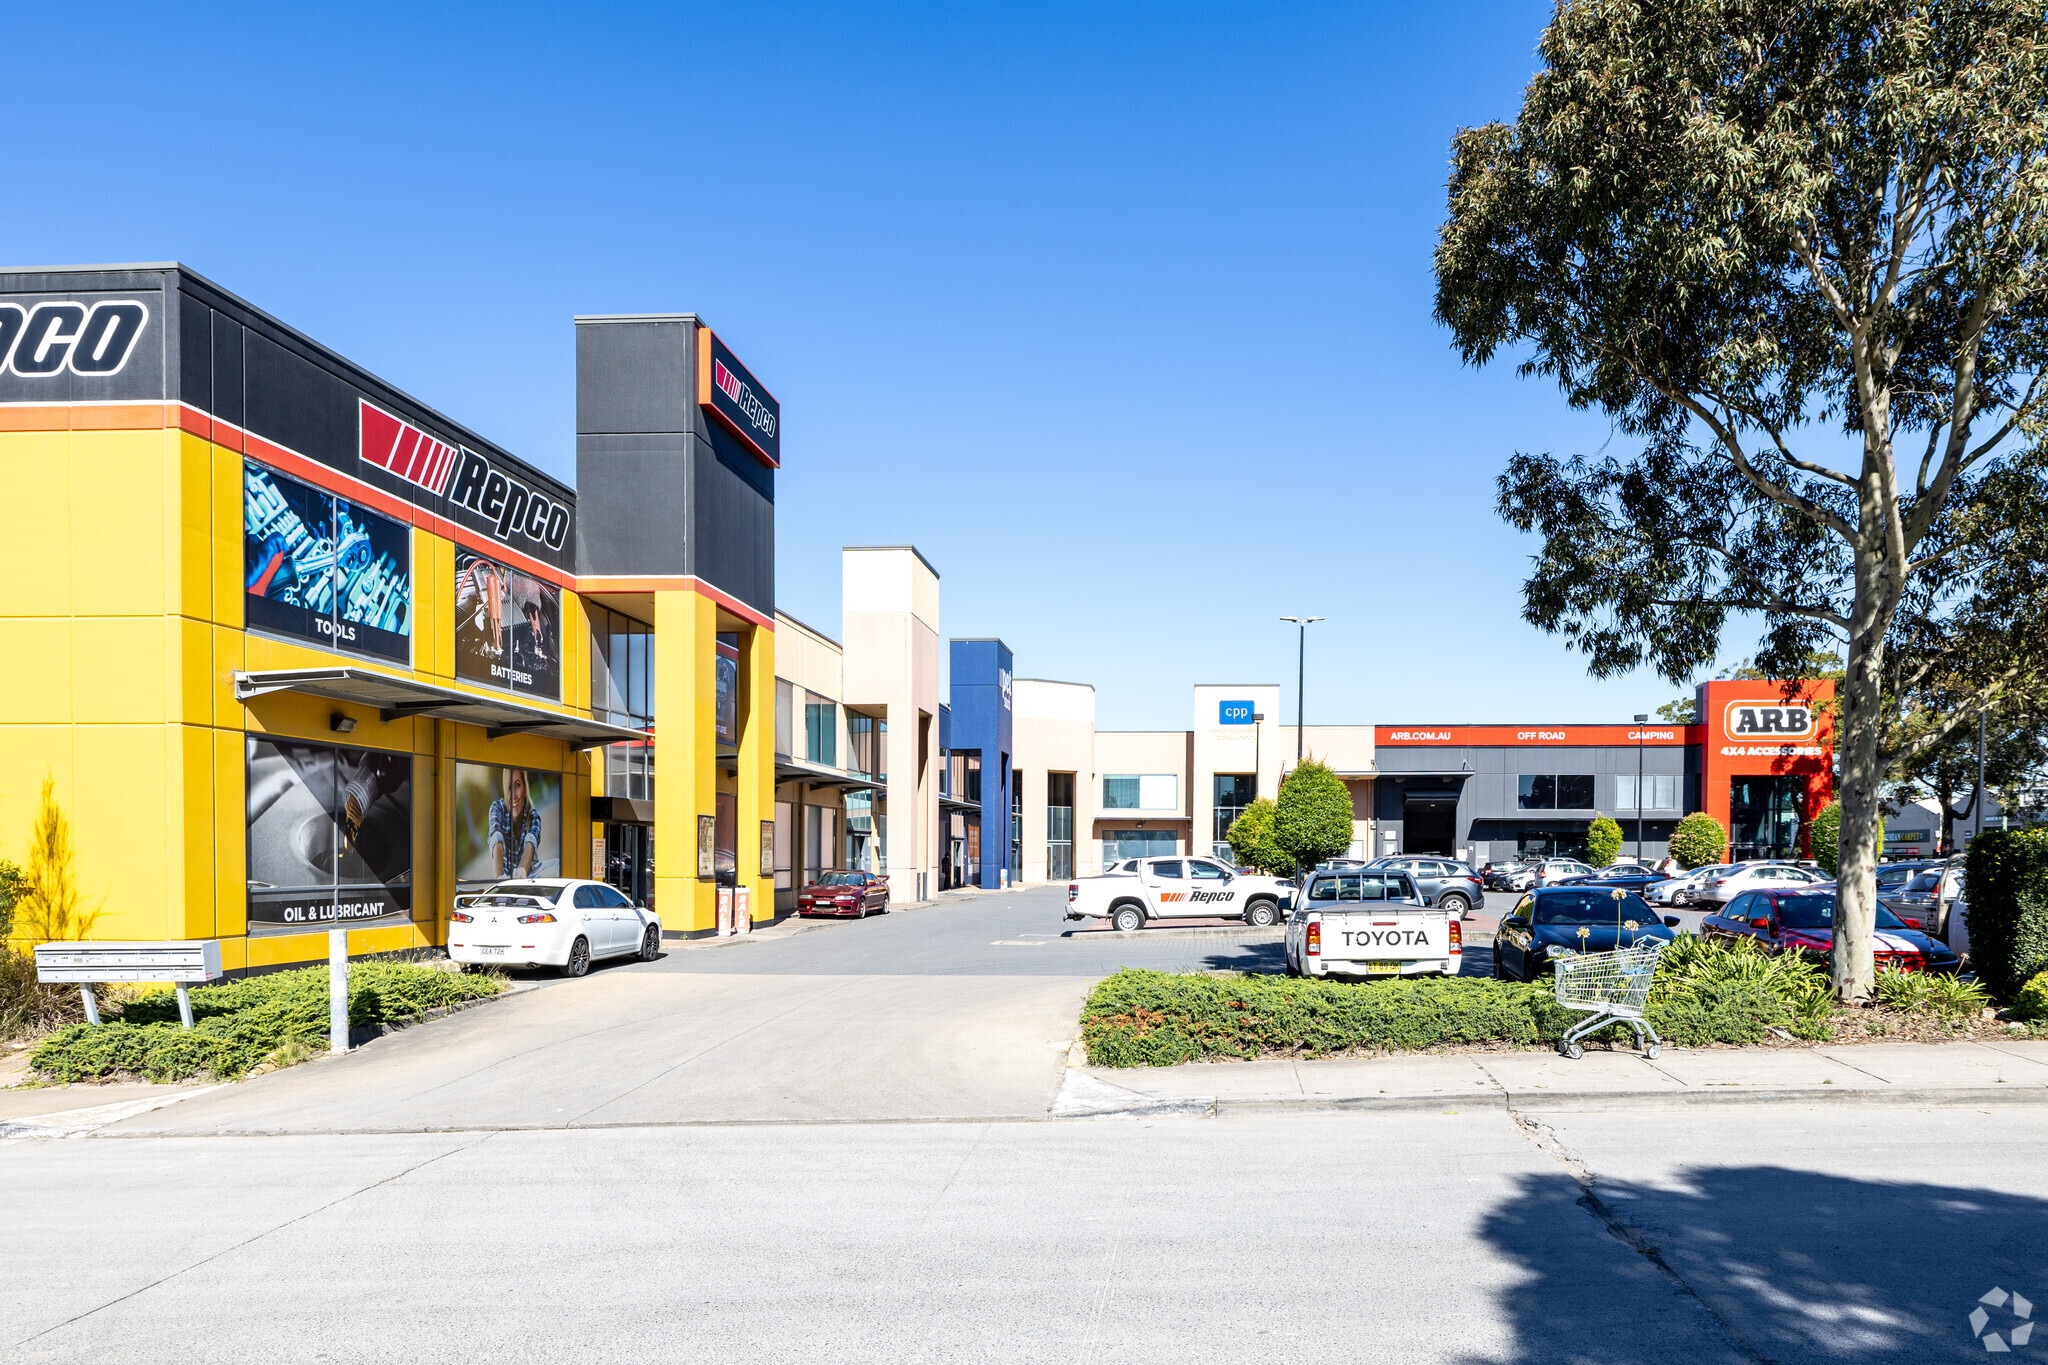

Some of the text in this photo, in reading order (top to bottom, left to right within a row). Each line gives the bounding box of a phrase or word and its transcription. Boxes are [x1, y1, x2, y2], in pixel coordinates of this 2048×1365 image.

[739, 381, 776, 438] Repco
[448, 443, 570, 551] Repco
[315, 618, 356, 641] TOOLS
[491, 664, 532, 685] BATTERIES
[1225, 707, 1248, 719] cpp
[1736, 709, 1808, 733] ARB
[1390, 732, 1451, 740] ARB.COM.AU
[1517, 732, 1566, 740] OFF ROAD
[1628, 732, 1674, 740] CAMPING
[1720, 746, 1822, 756] 4X4 ACCESSORIES
[1189, 890, 1235, 904] Repco
[284, 902, 385, 922] OIL & LUBRICANT
[1341, 931, 1429, 946] TOYOTA
